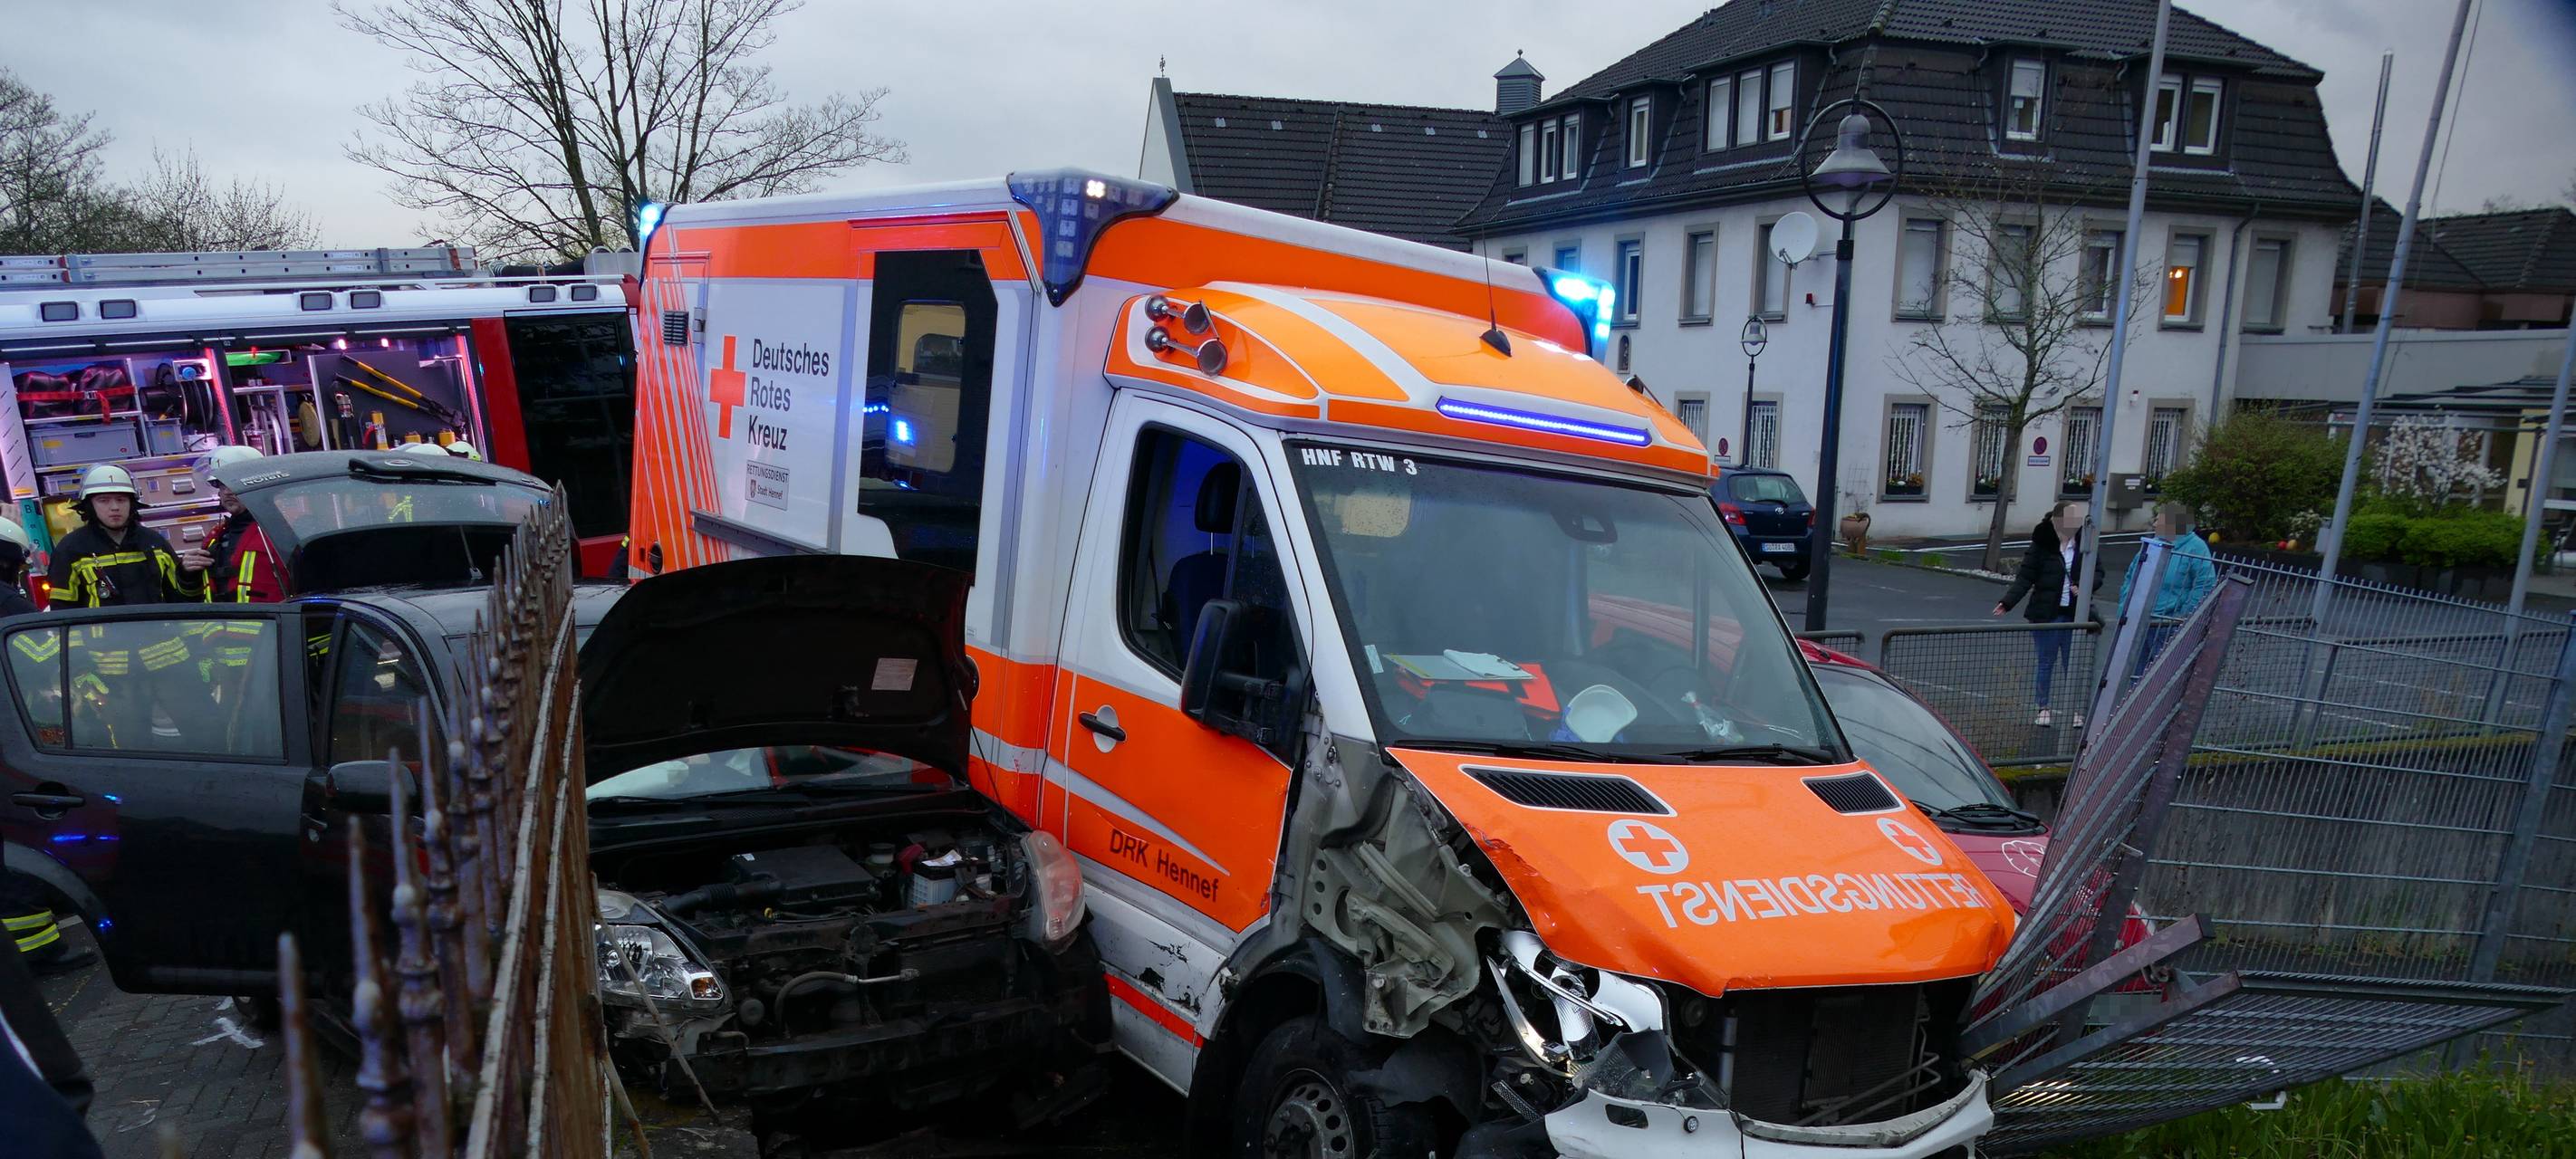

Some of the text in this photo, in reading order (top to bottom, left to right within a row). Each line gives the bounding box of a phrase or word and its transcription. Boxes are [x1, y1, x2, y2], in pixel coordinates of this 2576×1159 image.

[753, 338, 830, 377] Deutsches
[750, 376, 791, 412] Rotes
[747, 414, 787, 451] Kreuz
[746, 463, 789, 484] RETTUNGSDIENST
[1301, 448, 1418, 476] HNF RTW 3
[1110, 828, 1220, 903] DRK Hennef
